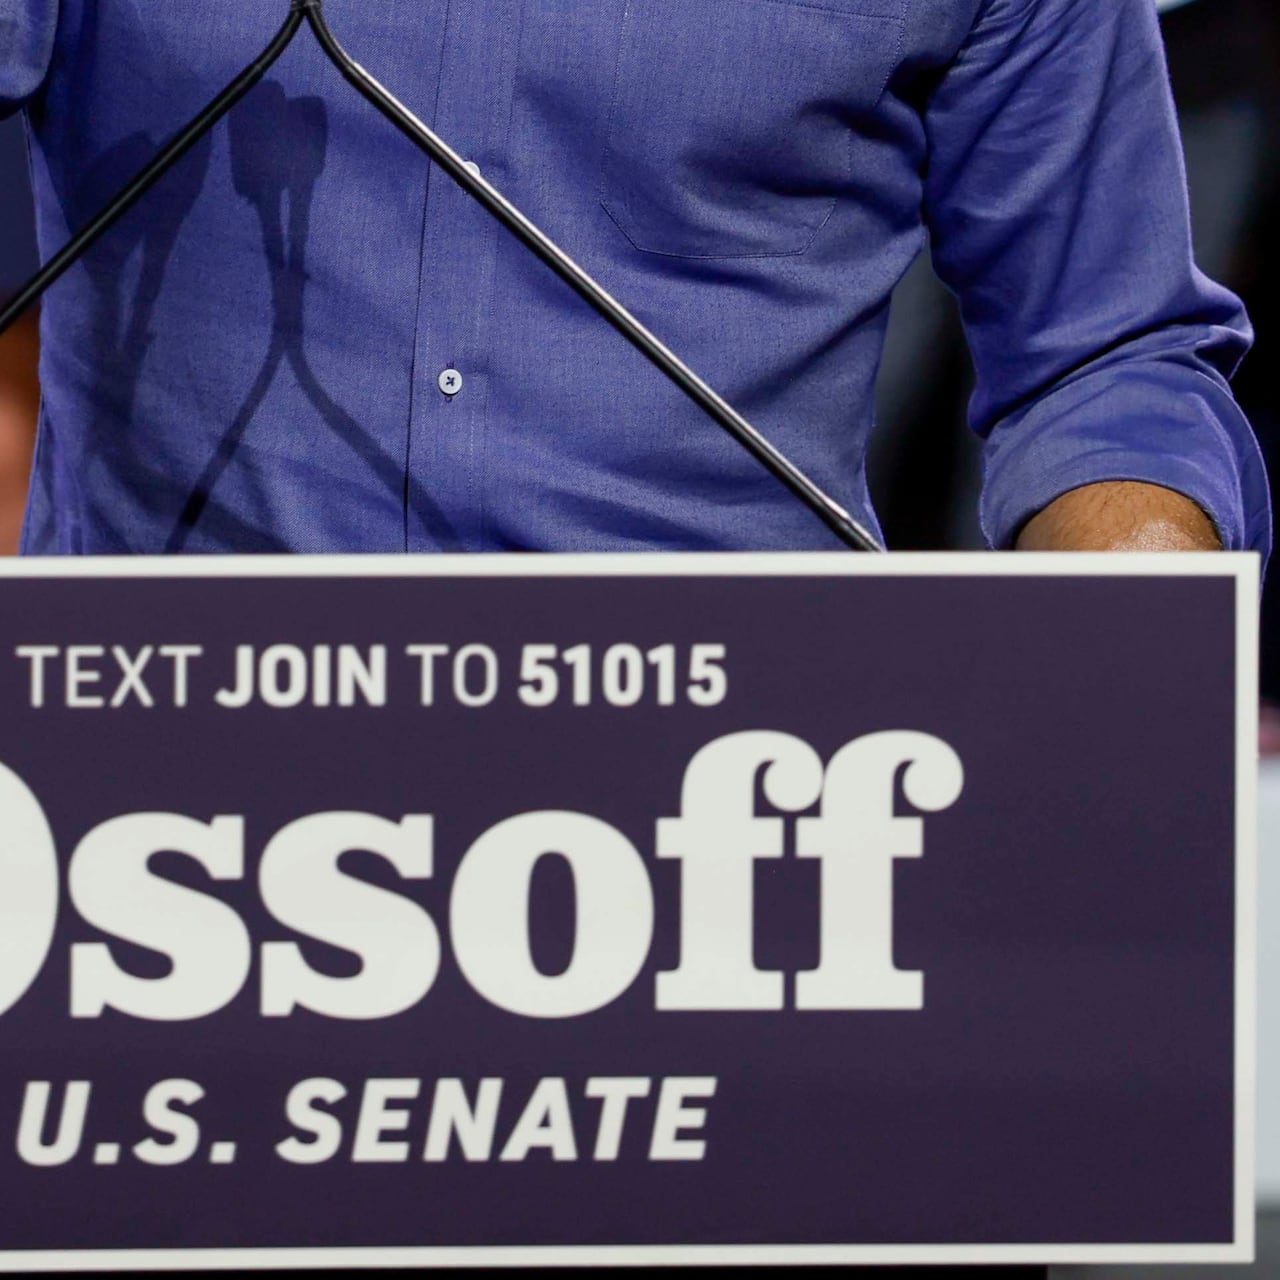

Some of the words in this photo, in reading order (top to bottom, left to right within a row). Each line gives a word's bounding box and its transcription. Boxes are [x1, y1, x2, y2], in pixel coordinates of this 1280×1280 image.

[18, 646, 201, 706] TEXT
[215, 645, 385, 707] JOIN
[408, 645, 497, 706] TO
[519, 644, 726, 706] 51015
[17, 1079, 235, 1166] U.S.
[276, 1077, 717, 1163] SENATE
